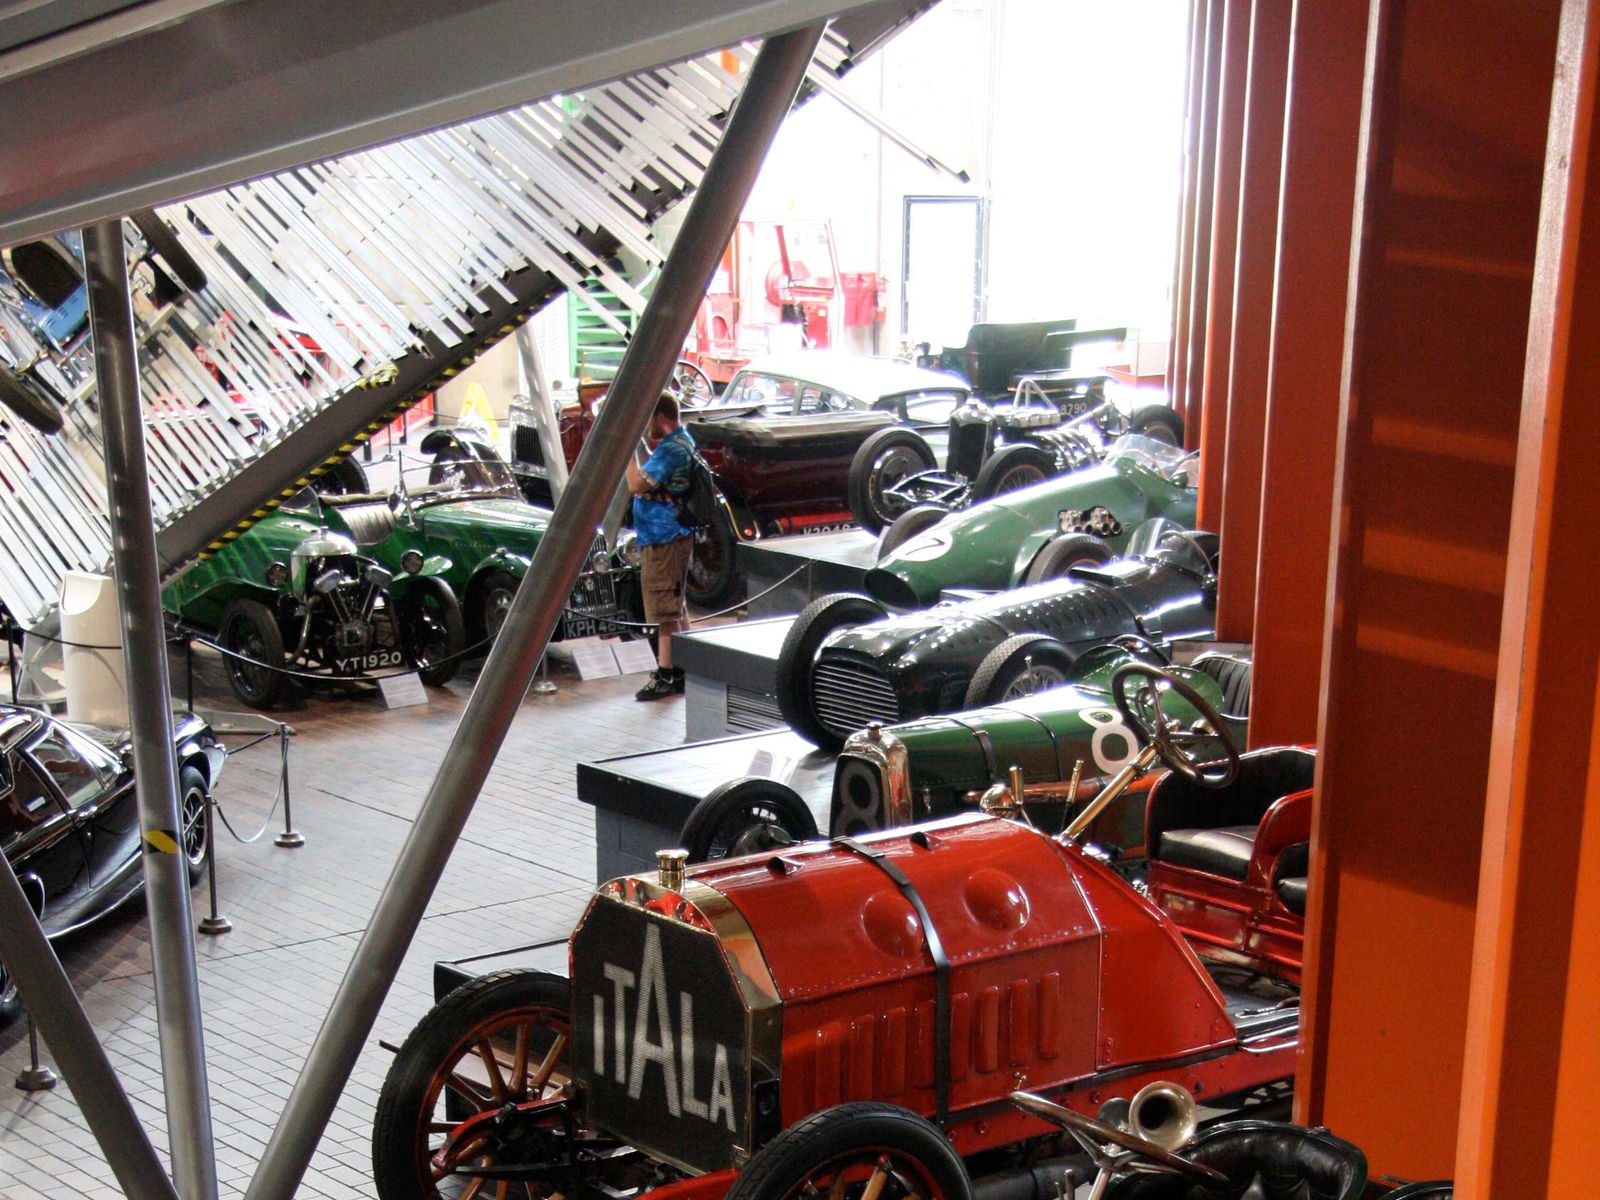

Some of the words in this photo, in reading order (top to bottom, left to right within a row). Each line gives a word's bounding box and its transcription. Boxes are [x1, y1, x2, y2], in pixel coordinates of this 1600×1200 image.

[1060, 402, 1087, 416] 8790
[566, 618, 596, 638] KPH
[336, 651, 402, 672] YT1920
[1078, 707, 1139, 775] 8
[592, 921, 737, 1133] ITALA
